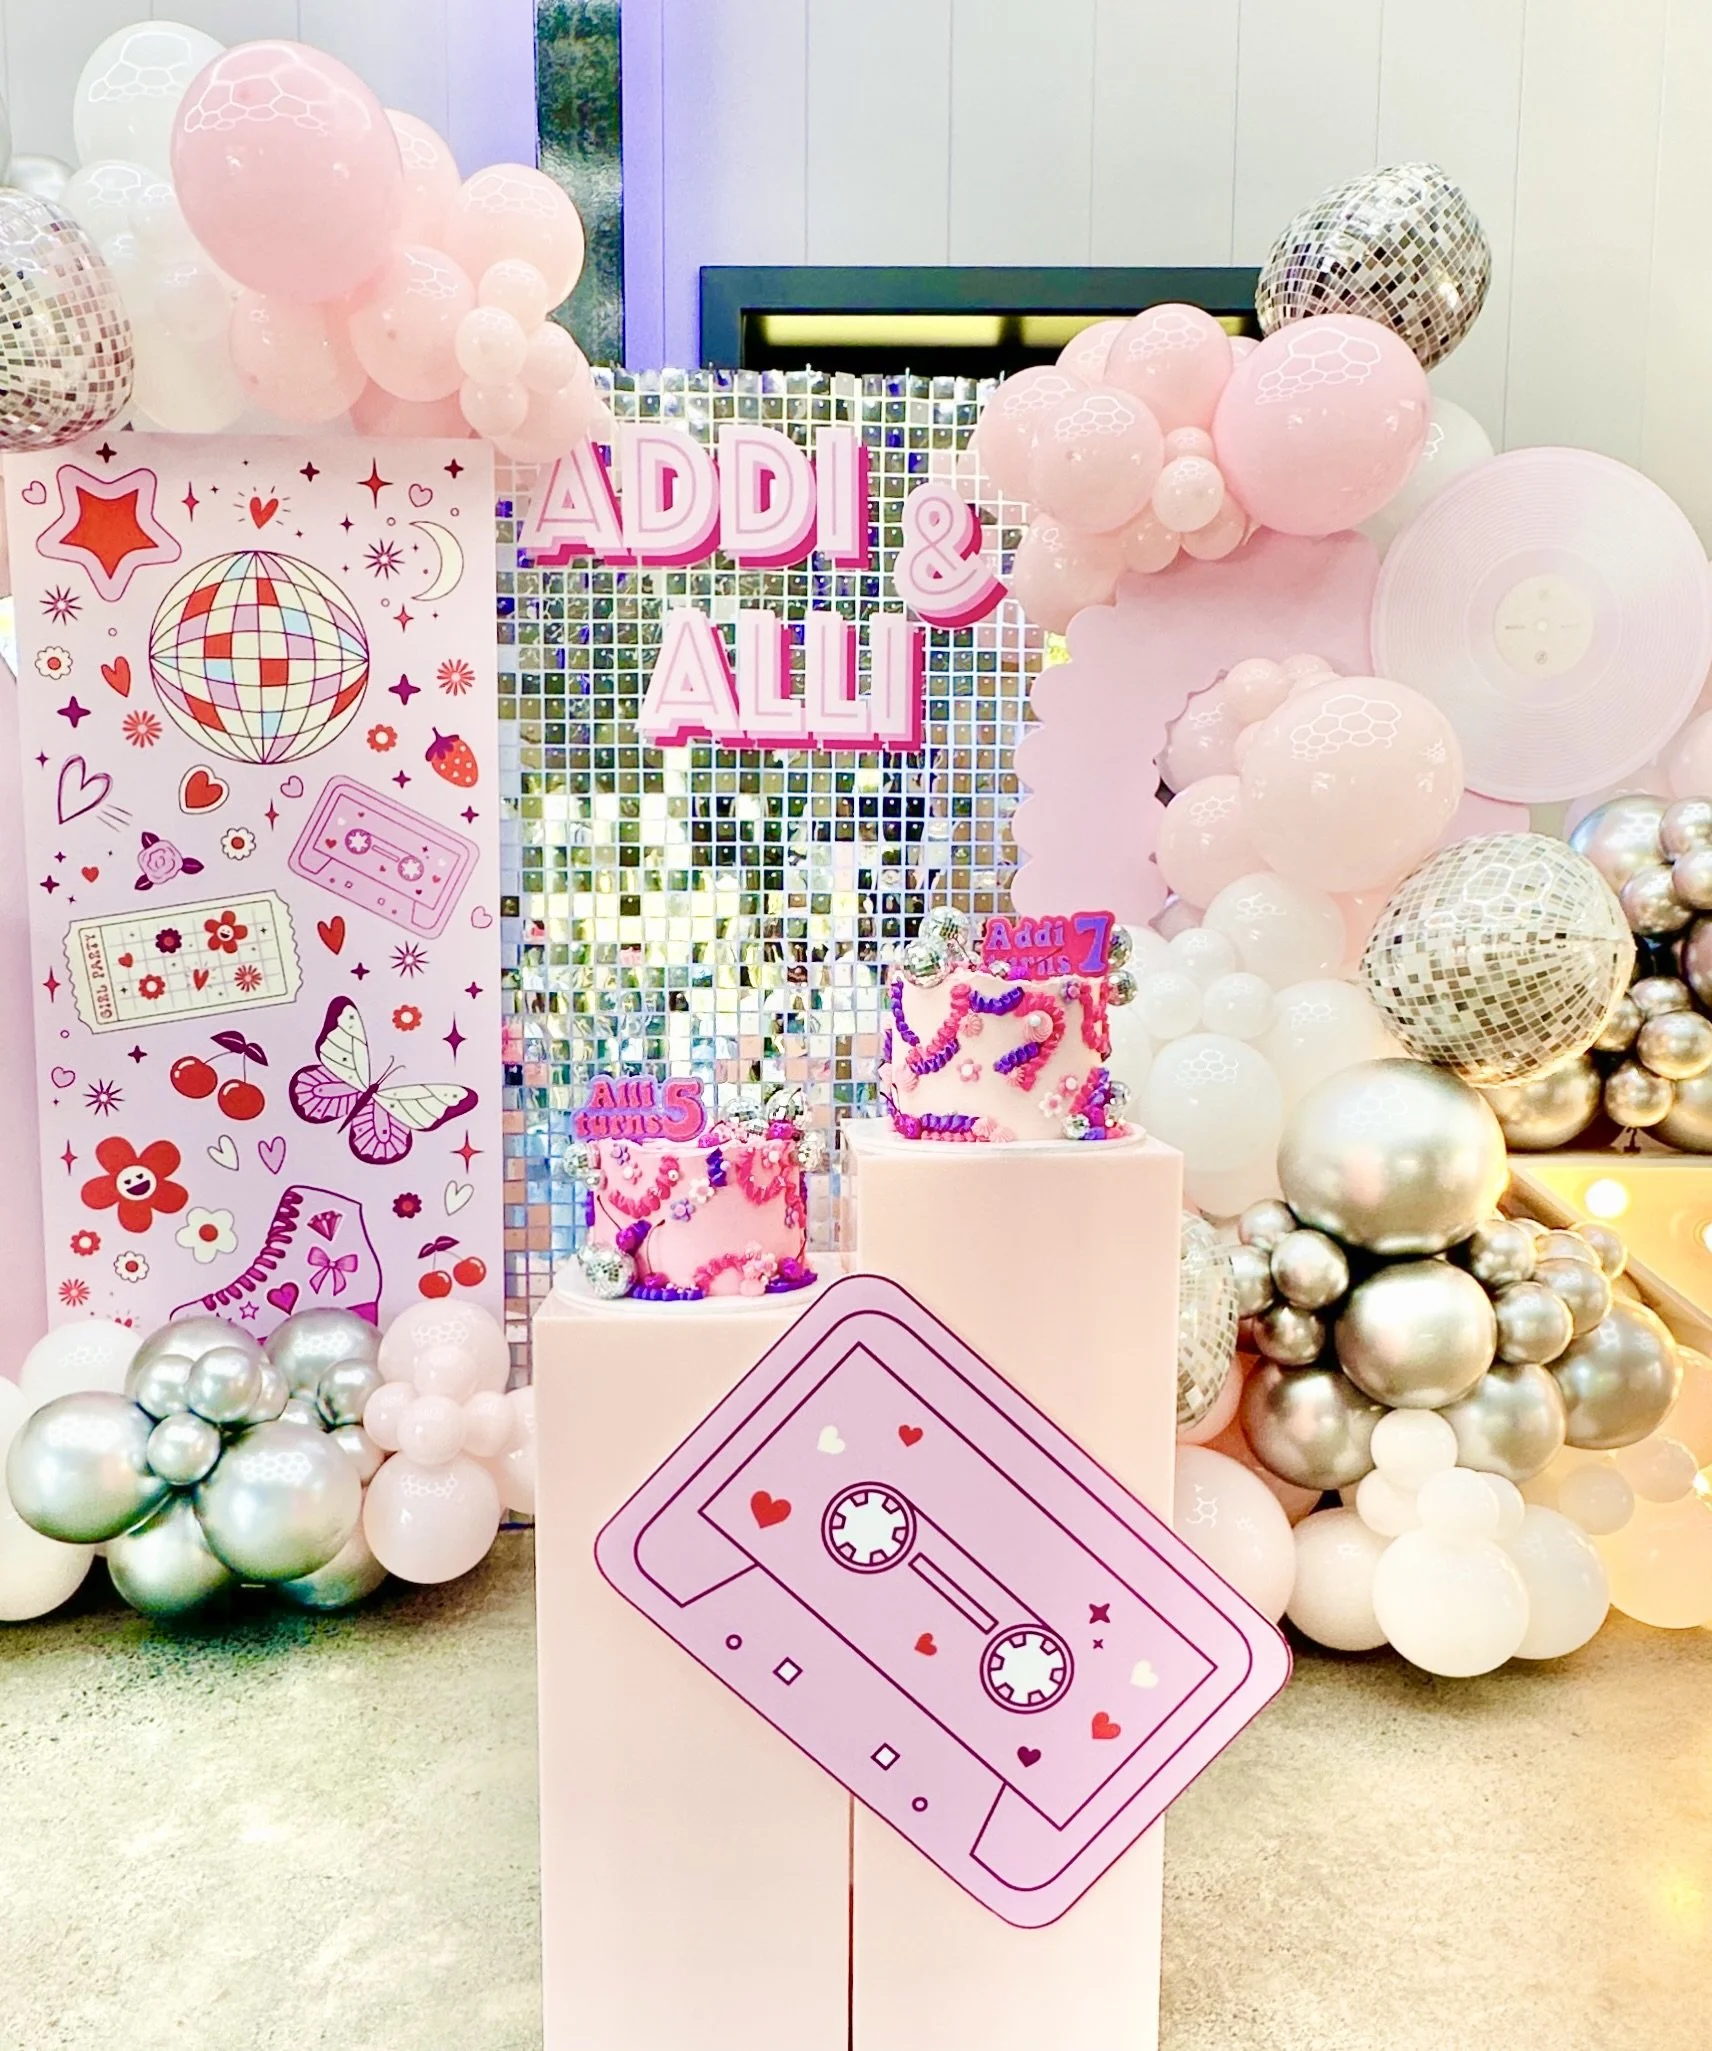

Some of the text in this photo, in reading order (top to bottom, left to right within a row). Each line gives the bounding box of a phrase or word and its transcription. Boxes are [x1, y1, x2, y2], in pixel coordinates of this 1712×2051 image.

[518, 424, 1008, 627] ADDI &
[637, 608, 922, 752] ALLI
[986, 922, 1065, 950] Addi
[1074, 915, 1109, 973] 7
[84, 934, 113, 1019] GIRL PARTY
[576, 1081, 703, 1140] turns 5
[589, 1081, 656, 1109] Alli
